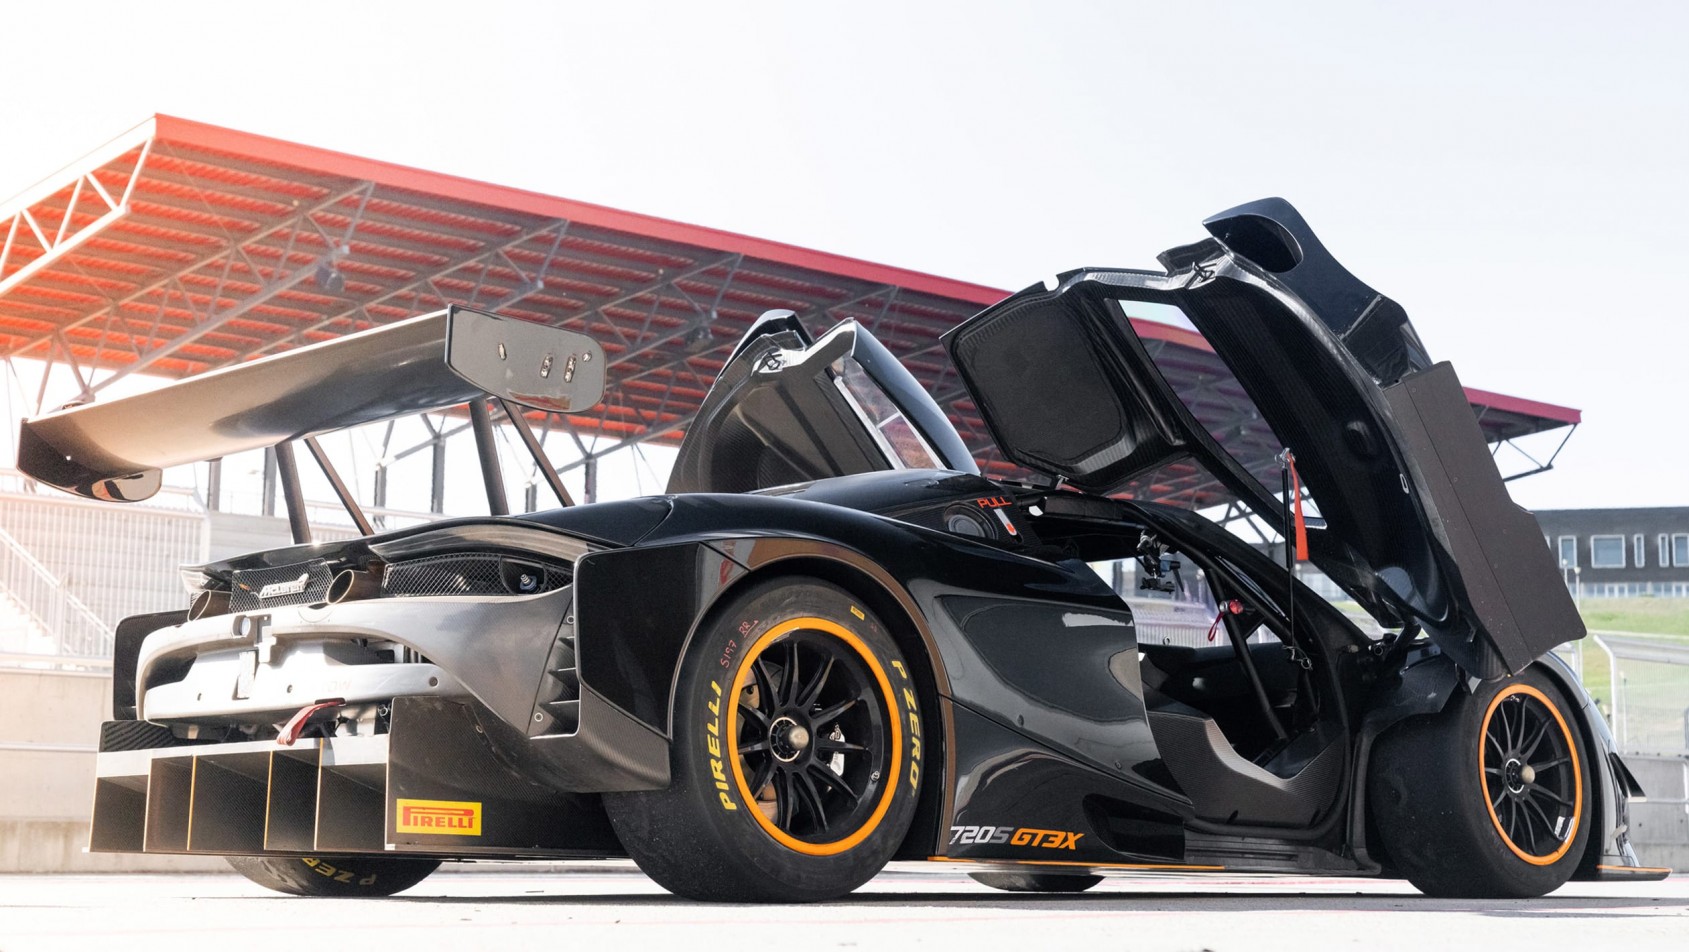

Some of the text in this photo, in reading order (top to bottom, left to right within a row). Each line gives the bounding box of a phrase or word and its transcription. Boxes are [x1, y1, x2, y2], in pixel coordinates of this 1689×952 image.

[977, 496, 1013, 509] PULL
[892, 660, 921, 791] P ZERO
[707, 680, 737, 811] PIRELLI
[403, 806, 474, 829] PIRELLI
[949, 826, 1085, 850] 720S GT3X
